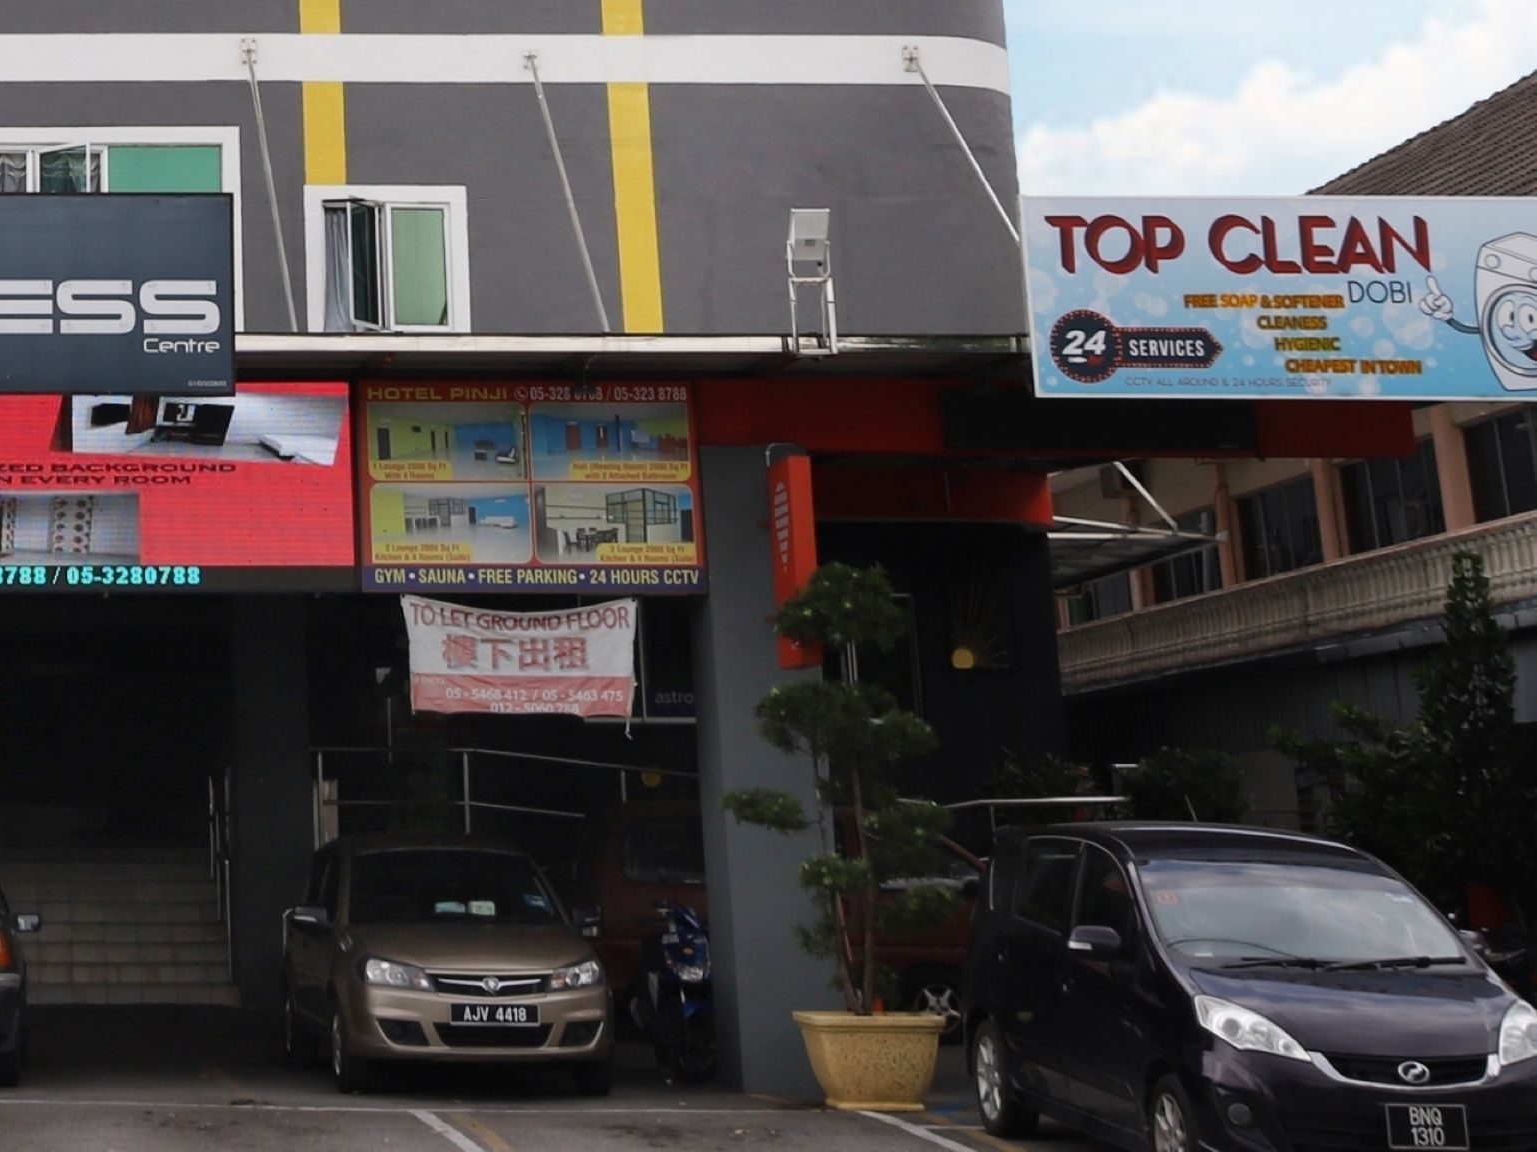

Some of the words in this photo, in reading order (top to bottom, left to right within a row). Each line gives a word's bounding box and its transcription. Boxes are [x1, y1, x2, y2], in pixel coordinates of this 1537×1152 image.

[1044, 214, 1185, 275] TOP
[1208, 214, 1432, 275] CLEAN
[1347, 280, 1412, 304] DOBI
[1184, 294, 1218, 309] FREE
[1219, 294, 1258, 309] SOAP
[1257, 315, 1328, 331] CLEANESS
[143, 337, 221, 354] Centre
[1062, 330, 1107, 356] 24
[1129, 339, 1205, 357] SERVICES
[1274, 337, 1341, 352] HYGIENIC
[1285, 359, 1356, 375] CHEAPEST
[1125, 377, 1152, 387] CCTV
[1156, 377, 1173, 387] ALL
[1178, 377, 1218, 387] AROUND
[1233, 377, 1245, 387] 24
[1249, 377, 1283, 387] HOURS
[1285, 377, 1331, 387] SECURITY
[367, 387, 442, 399] HOTEL
[450, 387, 507, 399] PINJI
[614, 387, 655, 401] 05-323
[658, 387, 687, 401] 8788
[51, 462, 237, 472] BACKGROUND
[20, 475, 106, 485] EVERY
[113, 475, 192, 485] ROOM
[66, 567, 201, 585] 05-3280788
[375, 568, 406, 584] GYM
[418, 568, 465, 584] SAUNA
[478, 568, 513, 584] FREE
[517, 568, 577, 584] PARKING
[589, 568, 606, 584] 24
[610, 568, 659, 584] HOURS
[664, 568, 699, 584] CCTV
[410, 602, 435, 626] TO
[441, 608, 473, 628] LET
[476, 612, 561, 631] GROUND
[566, 606, 631, 630] FLOOR
[463, 1005, 489, 1023] AJV
[494, 1005, 527, 1023] 4418
[1409, 1106, 1442, 1127] BNQ
[1410, 1127, 1445, 1146] 1310
